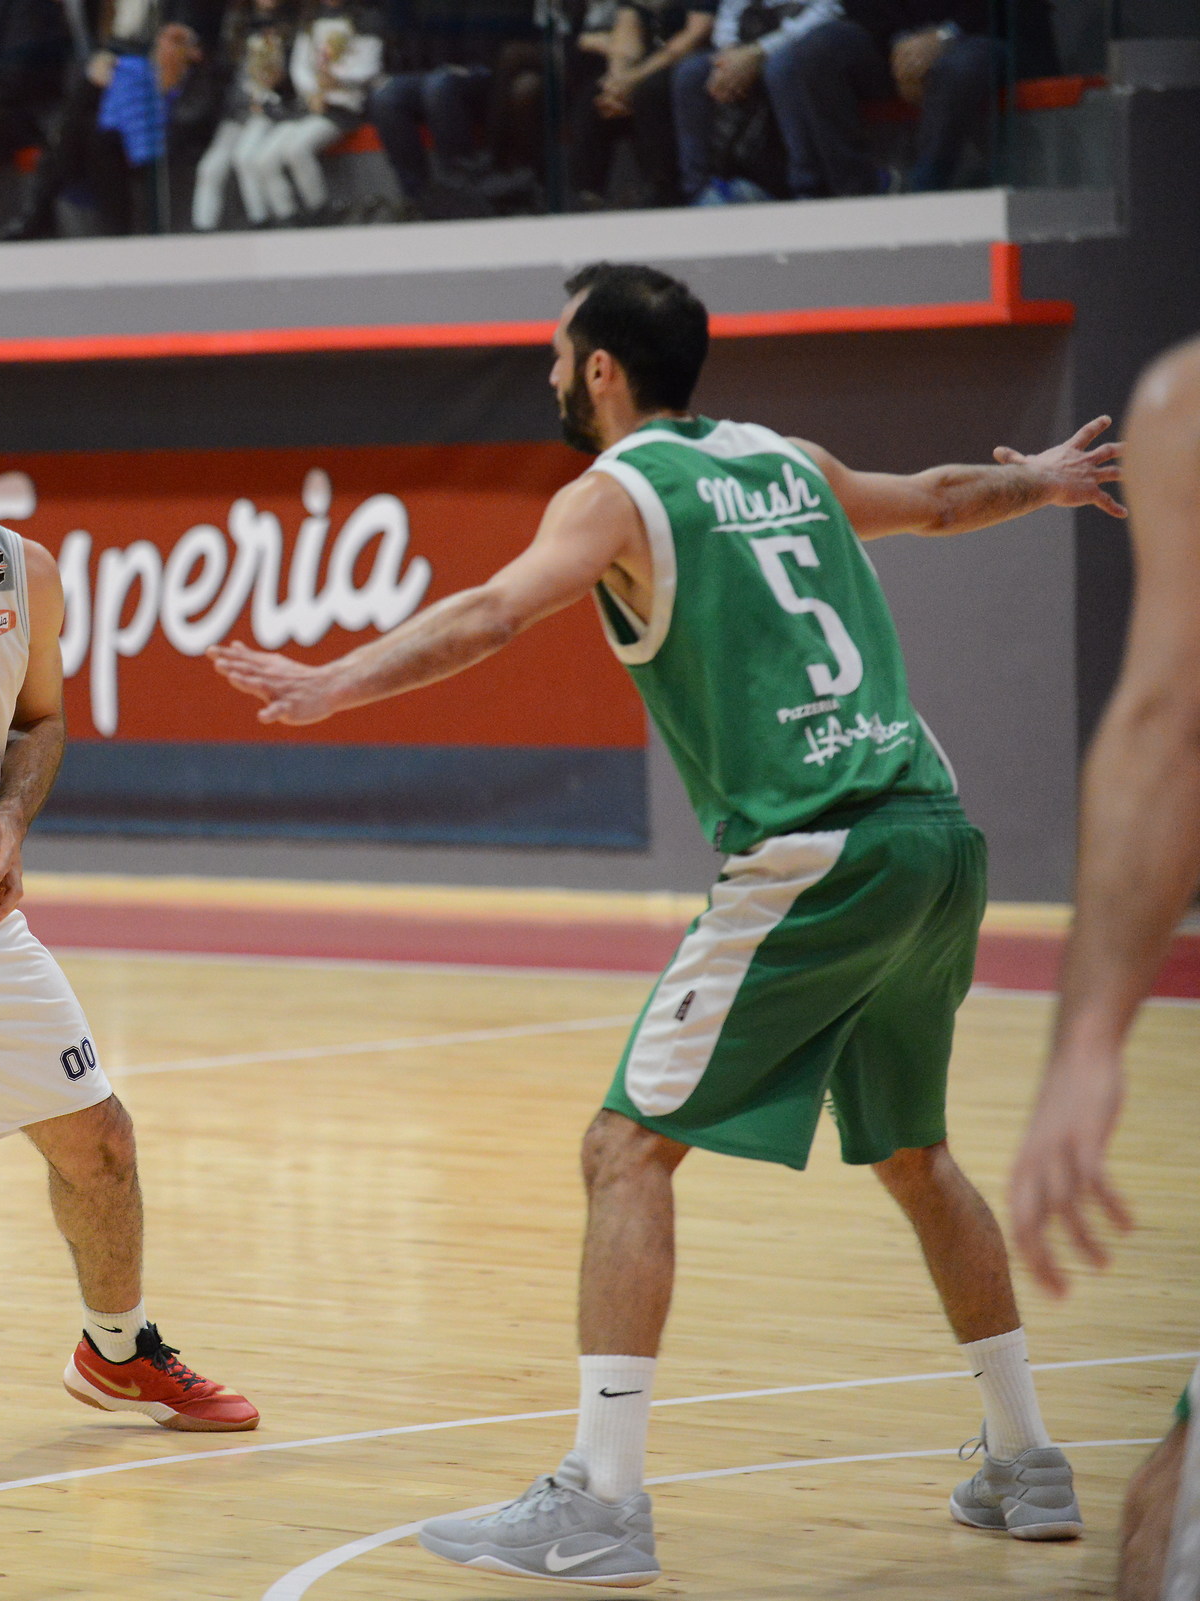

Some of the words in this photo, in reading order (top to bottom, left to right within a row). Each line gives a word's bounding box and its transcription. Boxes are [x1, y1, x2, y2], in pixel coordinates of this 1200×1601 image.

[696, 462, 820, 523] Mush
[750, 535, 864, 697] 5
[59, 1036, 97, 1081] 00
